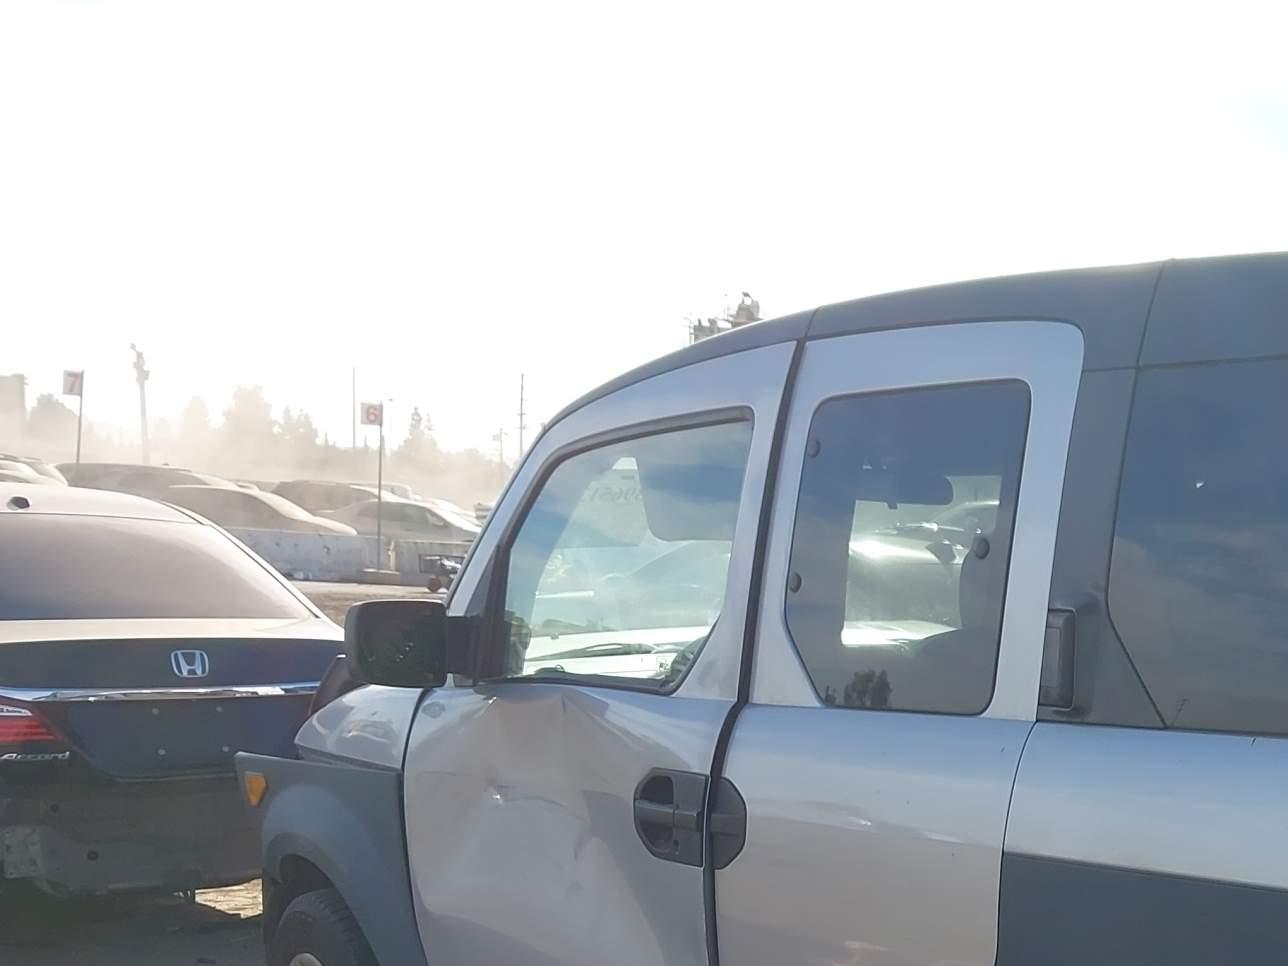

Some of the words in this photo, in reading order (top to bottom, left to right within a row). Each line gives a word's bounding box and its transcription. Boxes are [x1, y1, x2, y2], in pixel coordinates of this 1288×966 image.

[67, 372, 80, 393] 7
[367, 405, 378, 423] 6
[1, 751, 70, 761] Accord
